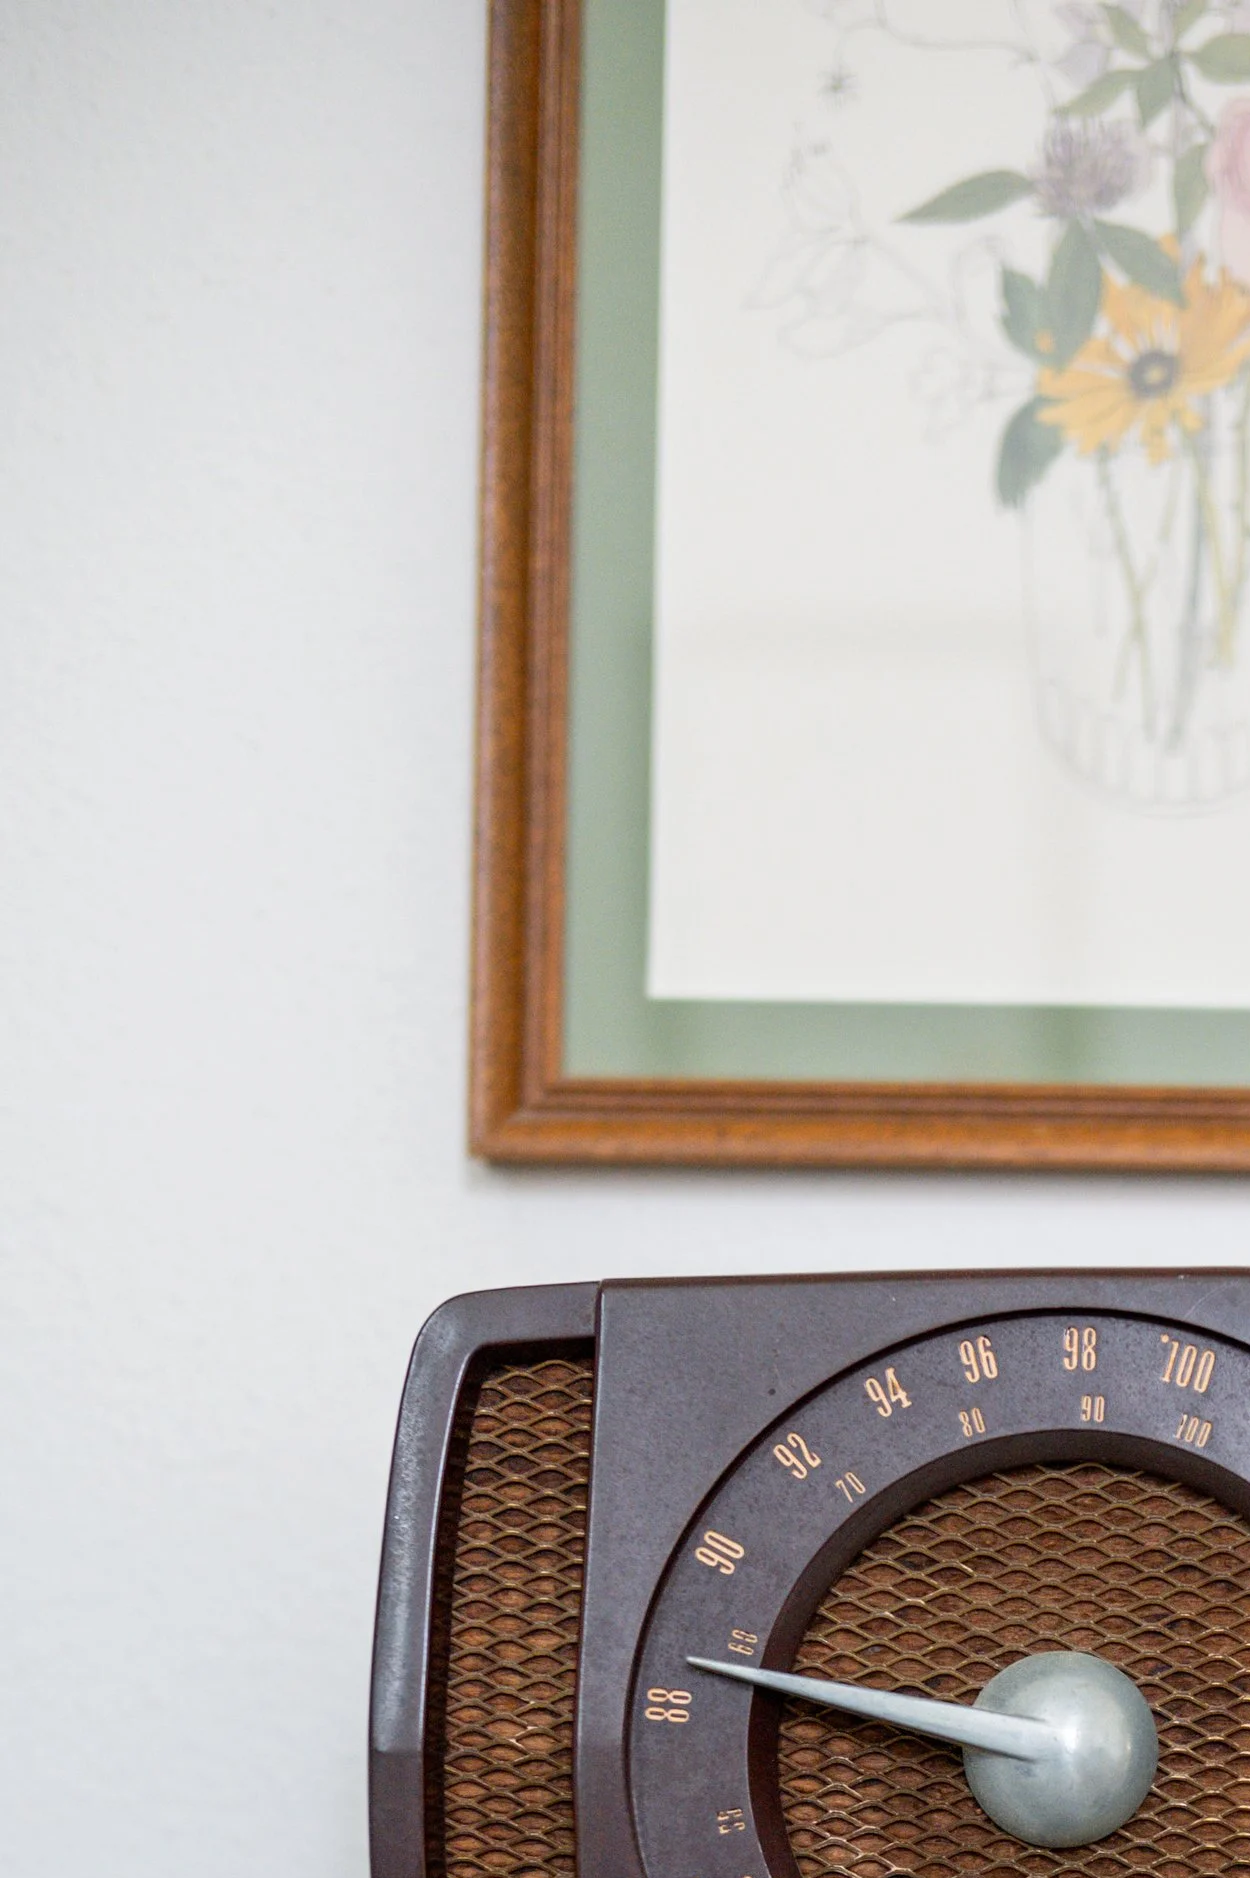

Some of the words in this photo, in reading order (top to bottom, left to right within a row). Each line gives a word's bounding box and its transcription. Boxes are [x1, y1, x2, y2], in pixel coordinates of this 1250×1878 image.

[644, 1687, 692, 1724] 88
[694, 1529, 746, 1576] 90
[772, 1431, 822, 1480] 92
[864, 1366, 912, 1419] 94
[959, 1335, 999, 1383] 96
[1063, 1327, 1098, 1372] 98
[1161, 1339, 1217, 1394] 100
[728, 1628, 759, 1657] 60
[835, 1470, 866, 1504] 70
[958, 1407, 985, 1437] 80
[1080, 1395, 1106, 1423] 90
[1174, 1413, 1213, 1448] 100
